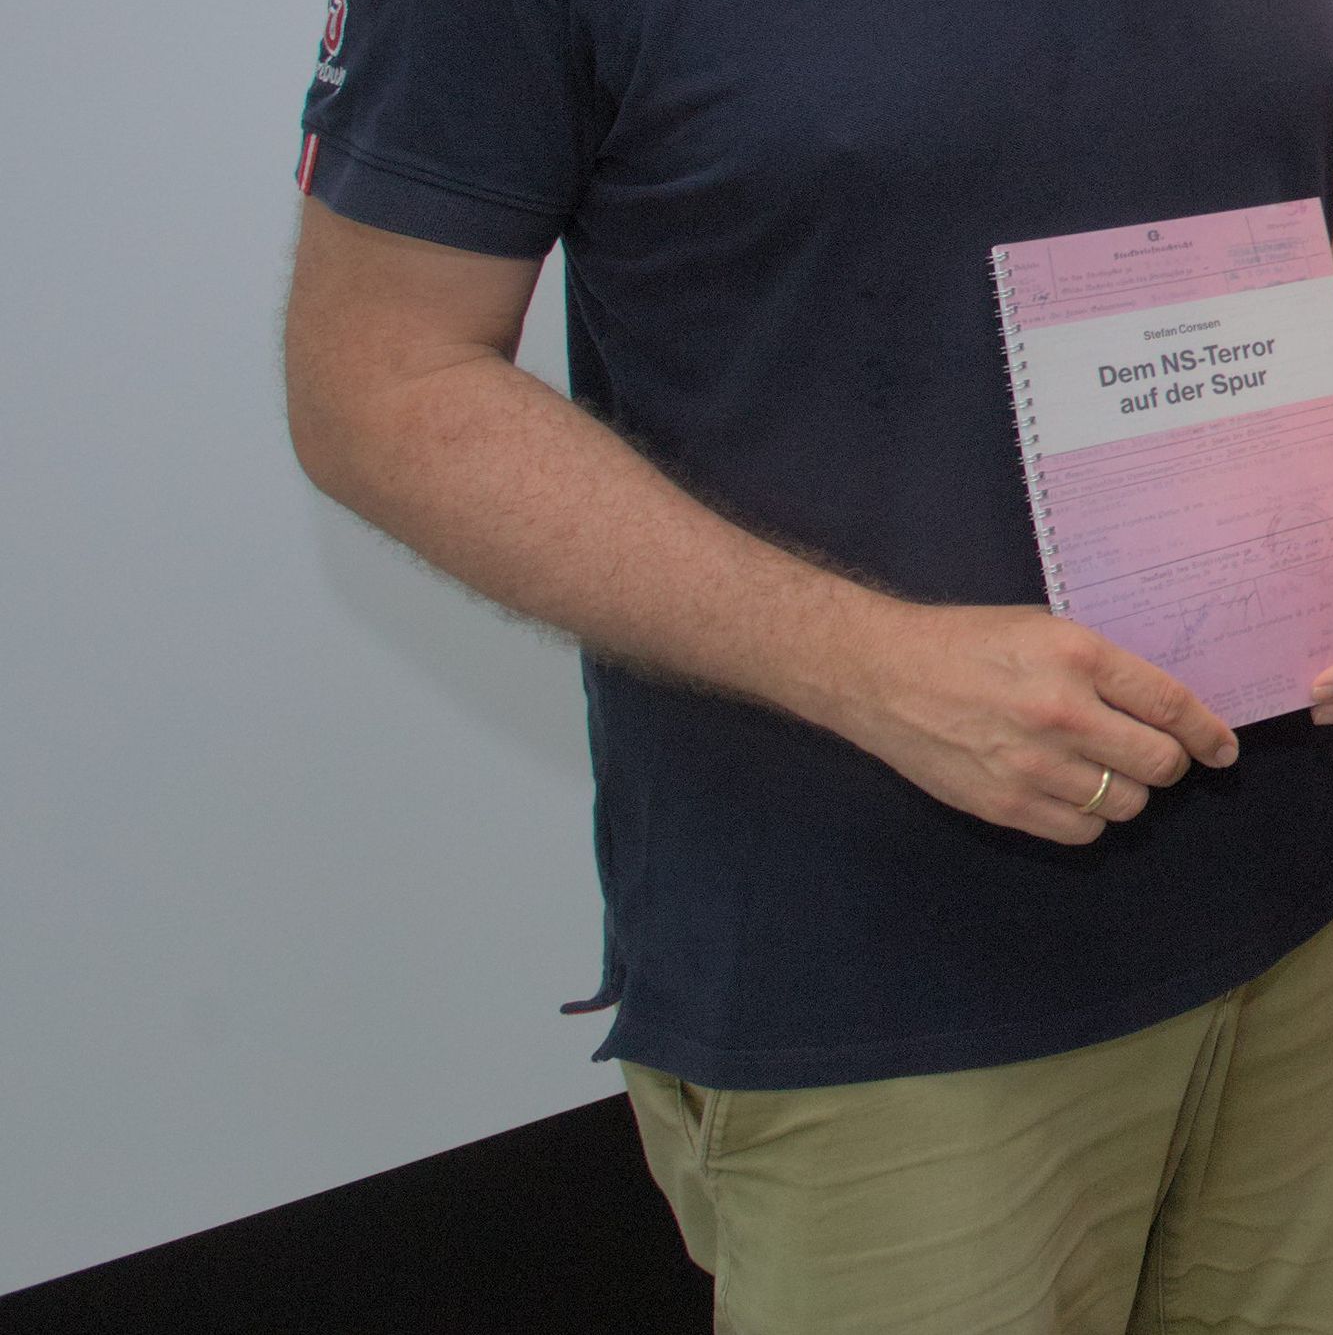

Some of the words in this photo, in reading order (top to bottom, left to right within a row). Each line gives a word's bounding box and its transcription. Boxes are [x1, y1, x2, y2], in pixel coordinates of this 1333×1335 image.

[1143, 326, 1178, 341] Stefan
[1178, 319, 1221, 335] Corssen
[1098, 361, 1156, 388] Dem
[1160, 338, 1275, 375] NS-Terror
[1119, 386, 1159, 415] auf
[1165, 380, 1205, 405] der
[1210, 369, 1267, 396] Spur
